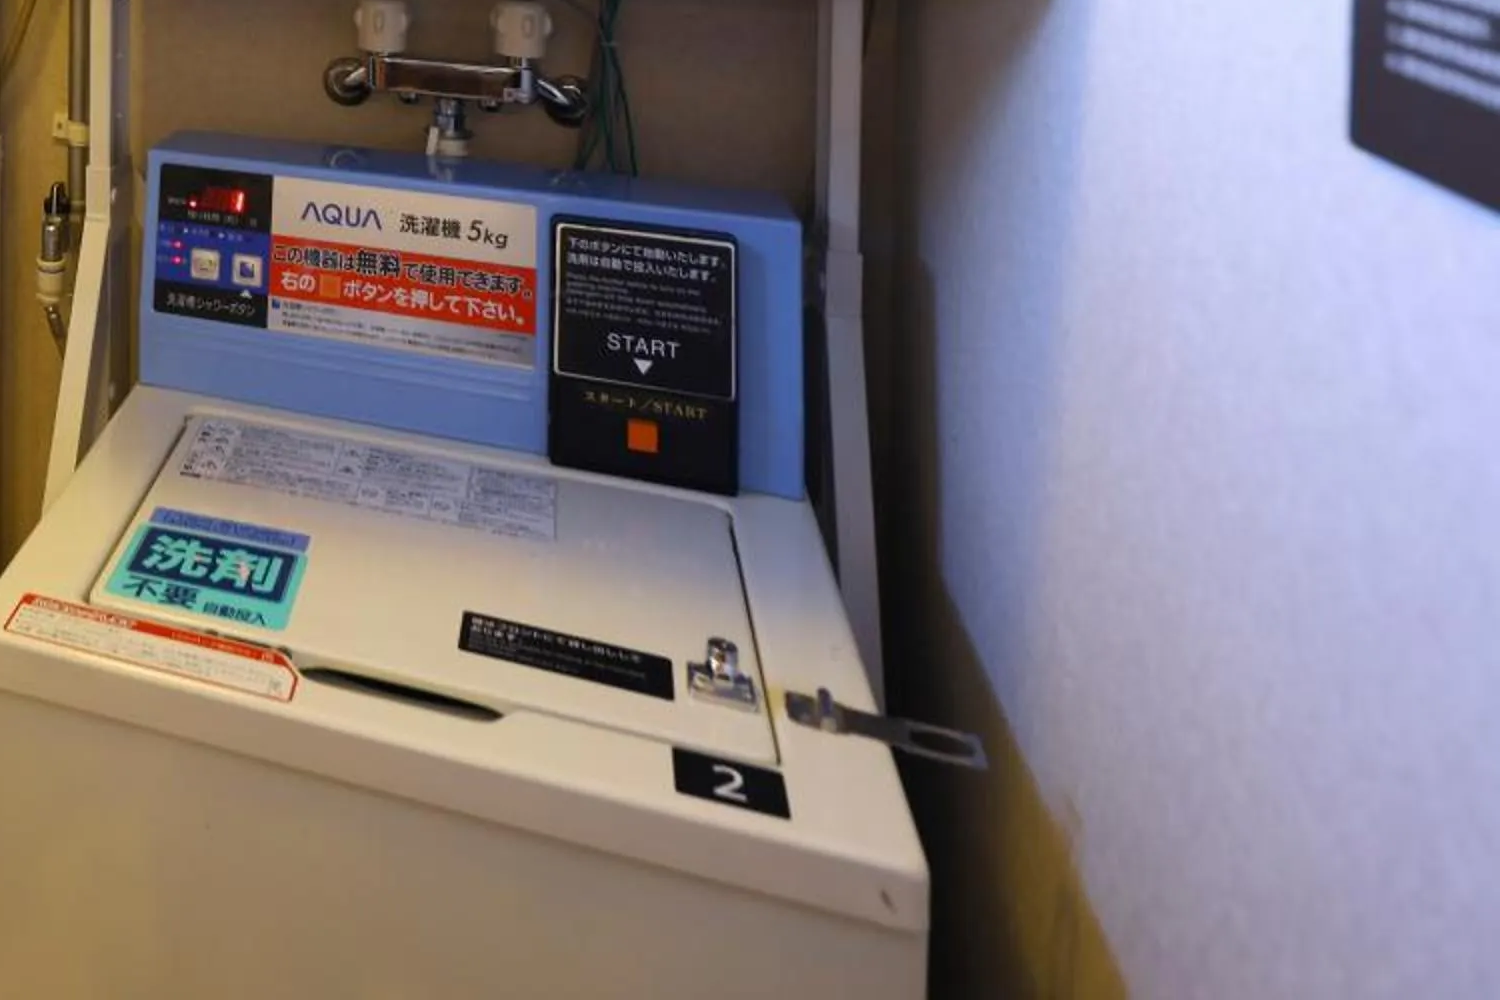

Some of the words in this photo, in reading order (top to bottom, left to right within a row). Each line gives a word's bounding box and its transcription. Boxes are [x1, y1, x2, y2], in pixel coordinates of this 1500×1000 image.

[302, 201, 383, 231] AQUA
[399, 212, 461, 240] 洗濯機
[467, 219, 509, 250] 5kg
[273, 245, 534, 299] この機器は無料で使用できます。
[280, 270, 317, 293] 右の
[343, 279, 525, 326] ボタンを押して下さい。
[606, 332, 681, 359] START
[143, 534, 284, 593] 洗剤
[122, 575, 199, 610] 不要
[203, 600, 267, 627] 自動投入
[711, 763, 748, 803] 2
